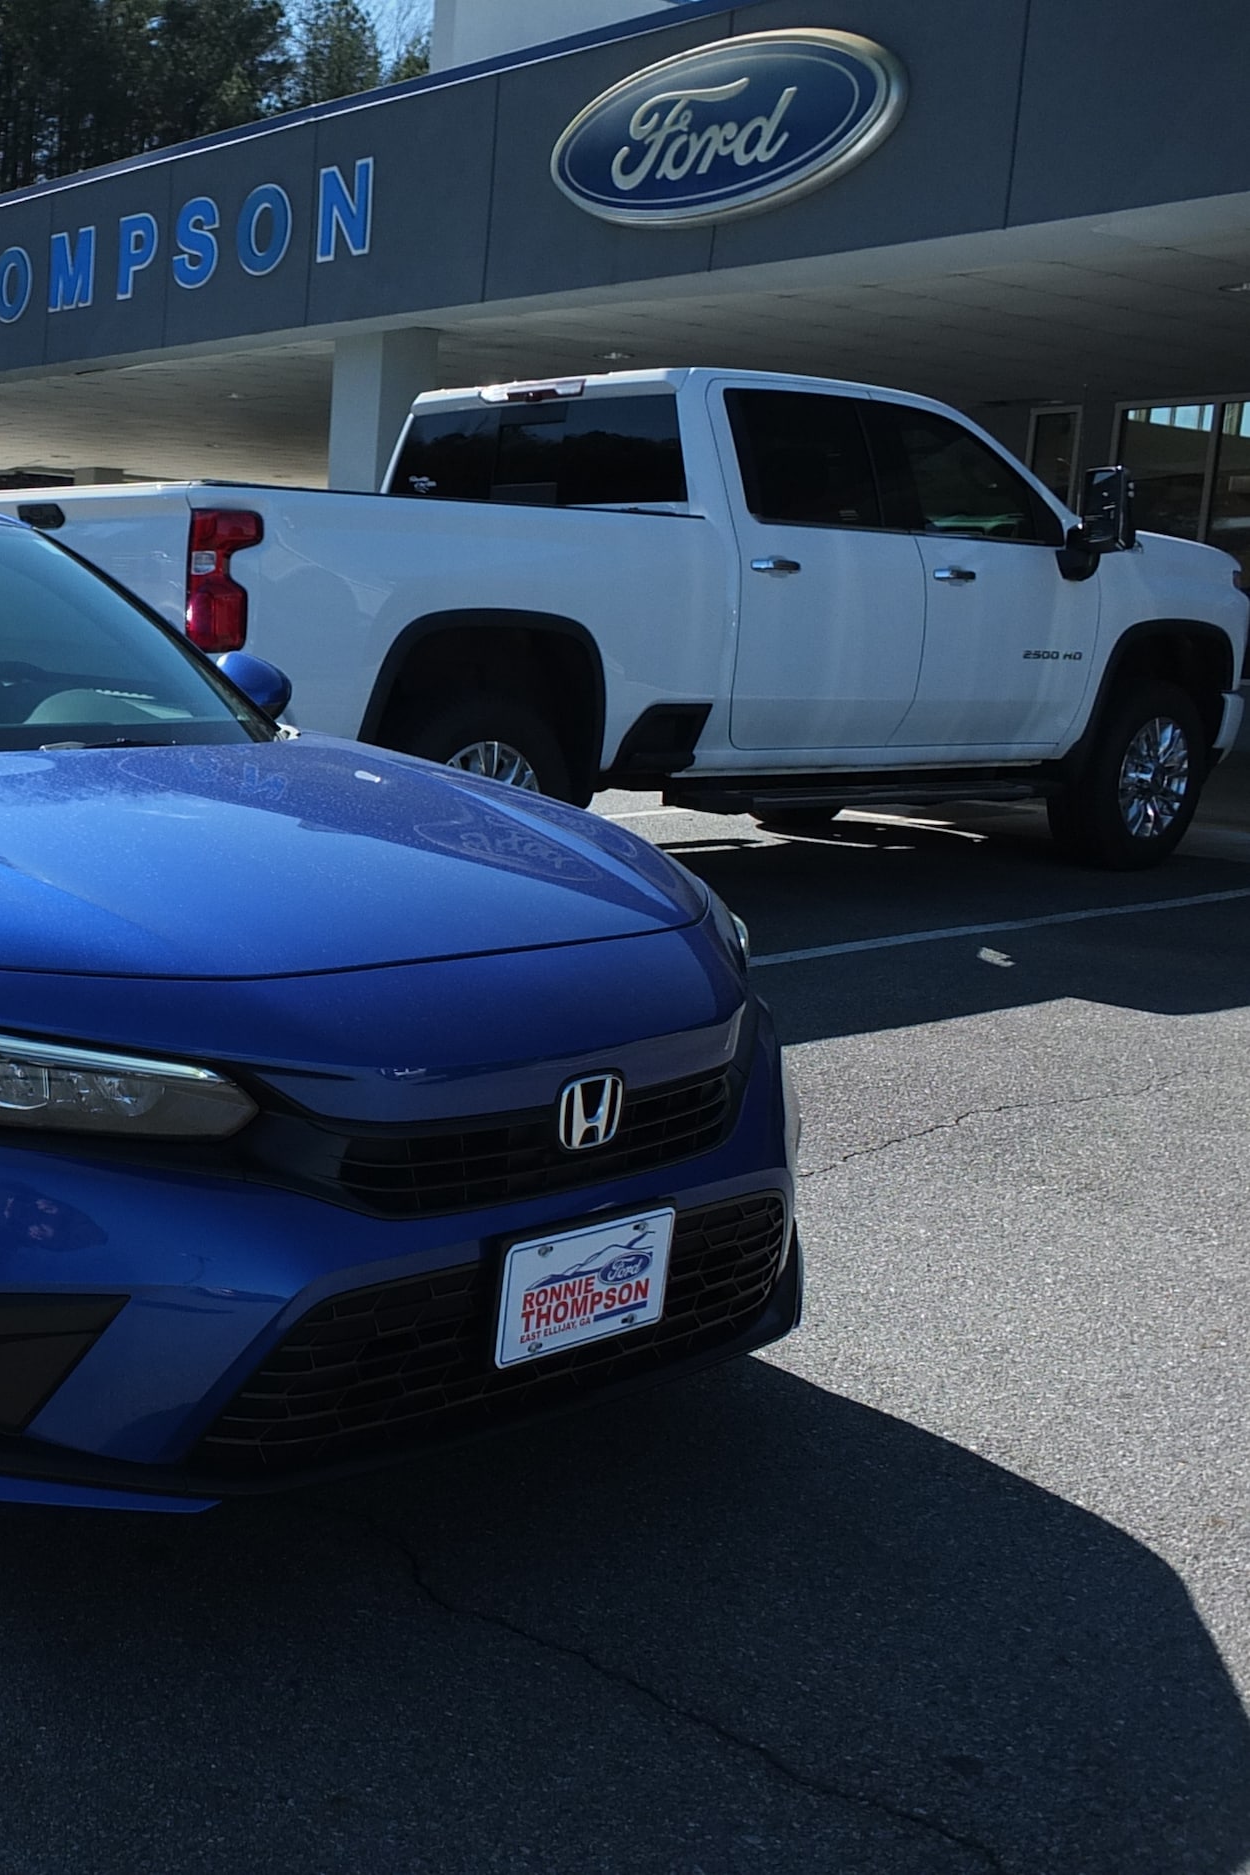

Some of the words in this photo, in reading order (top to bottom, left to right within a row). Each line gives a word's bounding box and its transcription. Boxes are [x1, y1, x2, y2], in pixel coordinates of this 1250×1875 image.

[610, 77, 798, 191] Ford
[1022, 650, 1060, 660] 2500
[1062, 651, 1083, 661] HD
[607, 1256, 643, 1280] Ford
[520, 1278, 649, 1333] THOMPSON
[522, 1275, 596, 1311] RONNIE
[519, 1330, 541, 1344] EAST
[579, 1317, 591, 1327] GA
